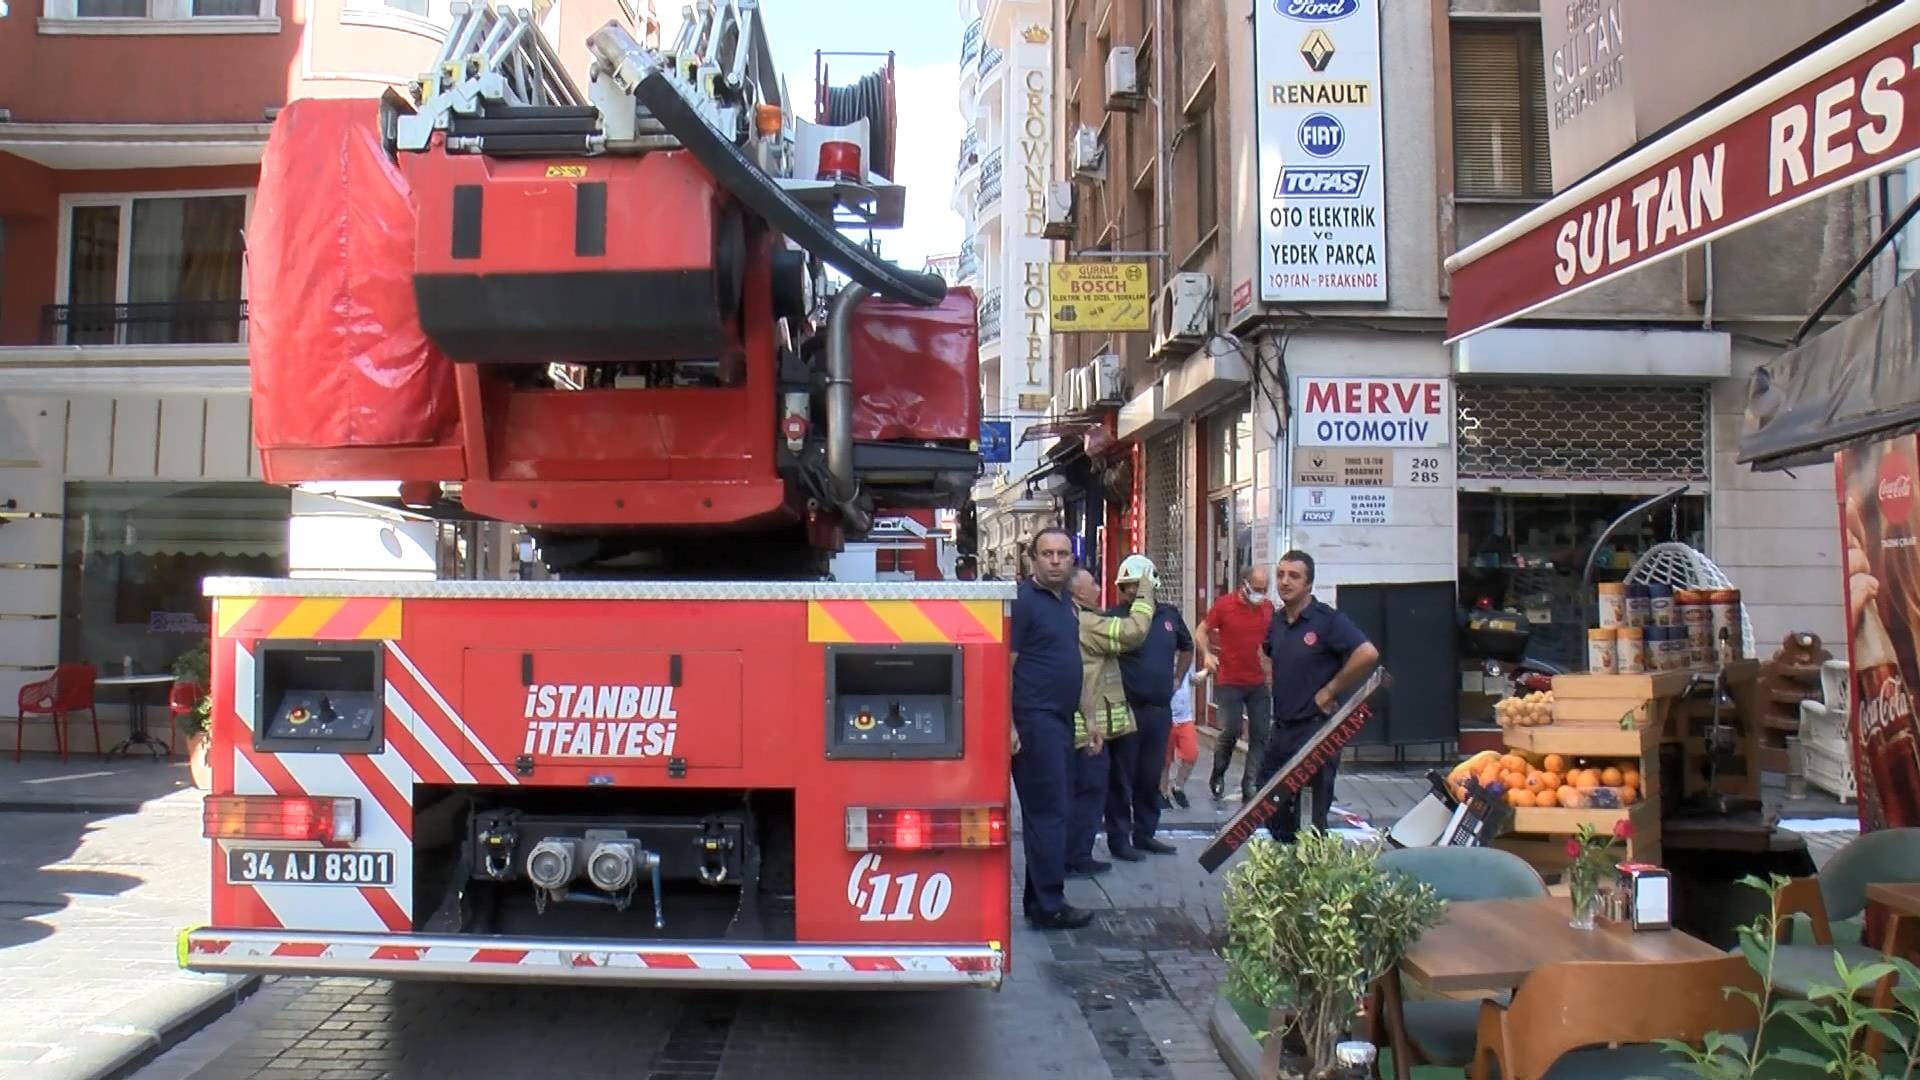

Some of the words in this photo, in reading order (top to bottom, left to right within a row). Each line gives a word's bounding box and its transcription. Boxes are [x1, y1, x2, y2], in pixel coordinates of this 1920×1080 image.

[1288, 0, 1345, 15] Ford
[1552, 0, 1623, 93] SULTAN
[1273, 84, 1368, 104] RENAULT
[1554, 53, 1624, 130] RESTAURANT
[1303, 126, 1340, 146] FIAT
[1021, 69, 1048, 236] CROWNED
[1286, 172, 1359, 193] TOFAŞ
[1270, 206, 1303, 228] OTO
[1309, 204, 1376, 228] ELEKTRİK
[1553, 142, 1726, 286] SULTAN
[1313, 231, 1334, 241] ve
[1270, 244, 1319, 265] YEDEK
[1326, 244, 1377, 269] PARÇA
[1071, 280, 1127, 293] BOSCH
[1024, 262, 1045, 386] HOTEL
[1304, 381, 1442, 415] MERVE
[1317, 417, 1429, 442] OTOMOTİV
[1344, 468, 1384, 476] BROADWAY
[1411, 458, 1439, 469] 240
[1301, 474, 1335, 483] RENAULT
[1344, 478, 1384, 486] FAIRWAY
[1410, 472, 1440, 484] 285
[1351, 516, 1386, 524] Tempra
[525, 684, 678, 719] İSTANBUL
[524, 721, 678, 757] İTFAİYESİ
[1283, 702, 1374, 794] RESTURANT
[242, 852, 275, 880] 34
[284, 852, 316, 881] AJ
[325, 853, 388, 882] 8301
[860, 872, 952, 921] 110
